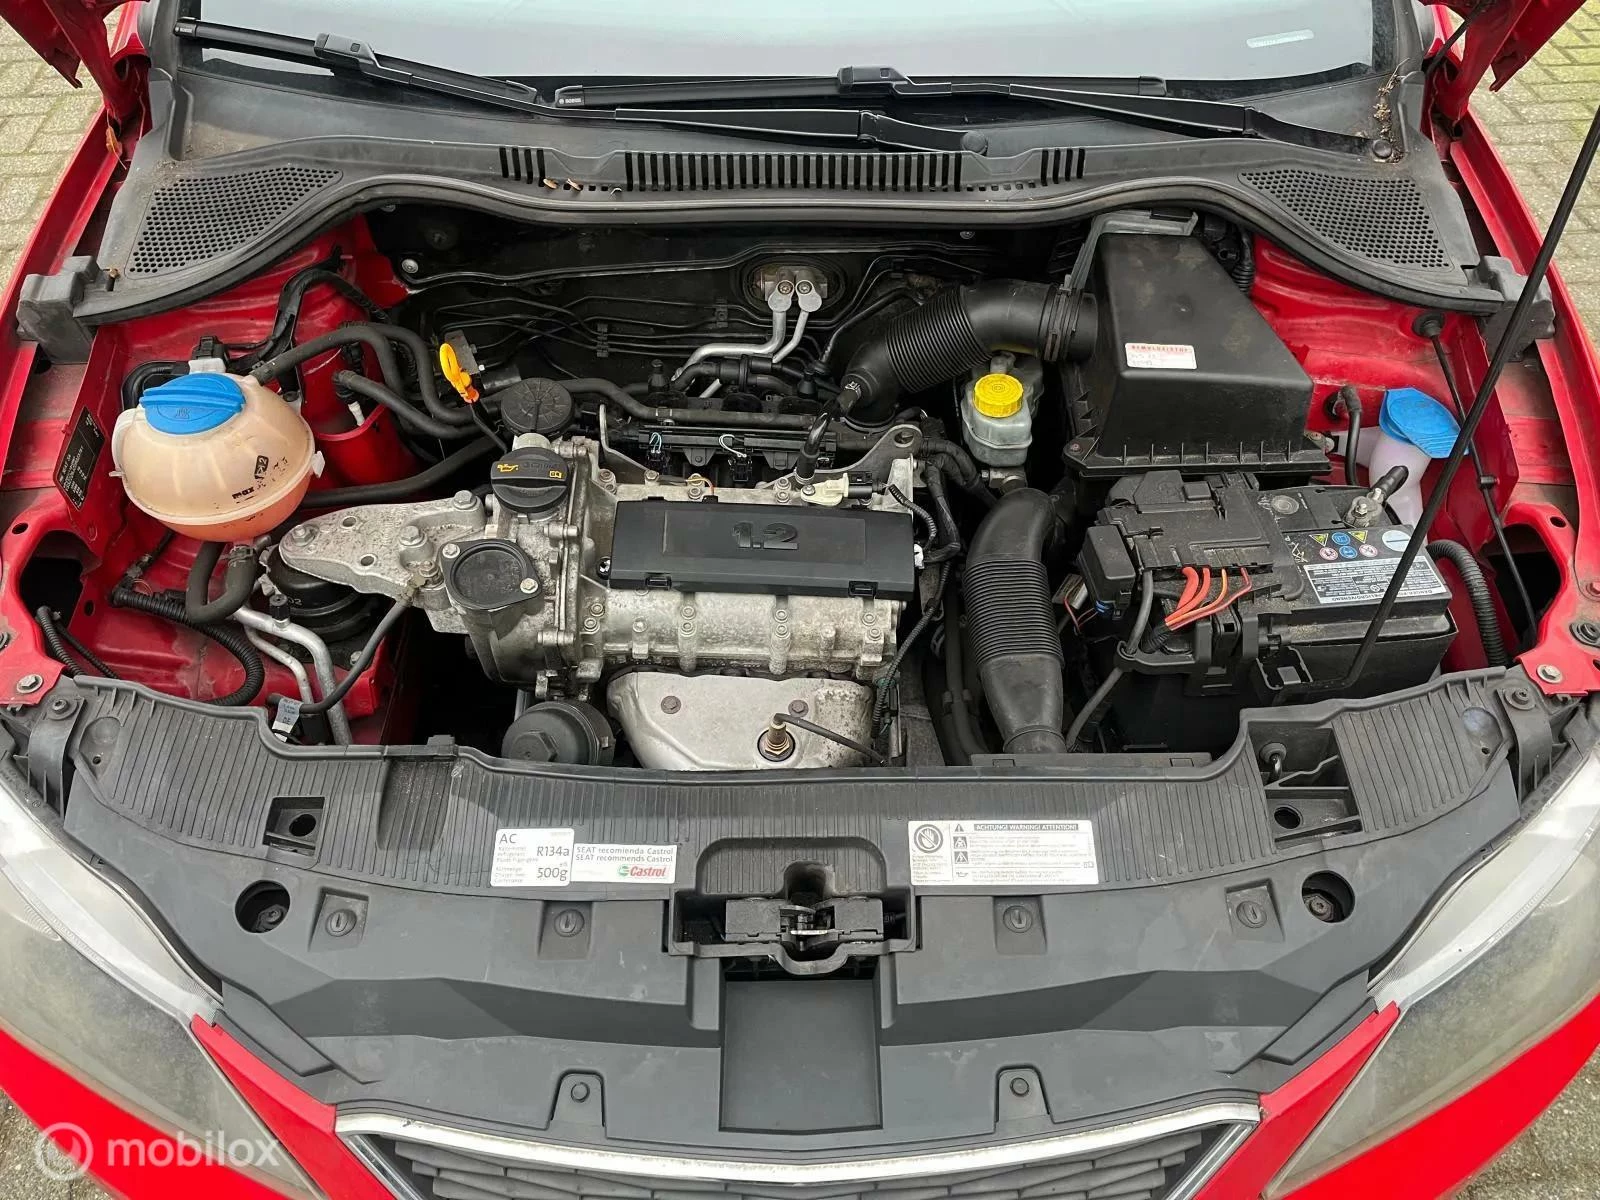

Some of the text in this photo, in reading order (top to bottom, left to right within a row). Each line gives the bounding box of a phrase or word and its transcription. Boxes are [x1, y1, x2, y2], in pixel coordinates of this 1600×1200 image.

[732, 521, 798, 550] 1.2
[499, 833, 517, 844] AC
[536, 846, 570, 857] R134a
[576, 846, 674, 855] SEAT recomienda Castrol
[596, 854, 645, 862] recommends
[646, 855, 673, 863] Castrol
[536, 867, 568, 881] 500g
[630, 865, 667, 877] Castrol
